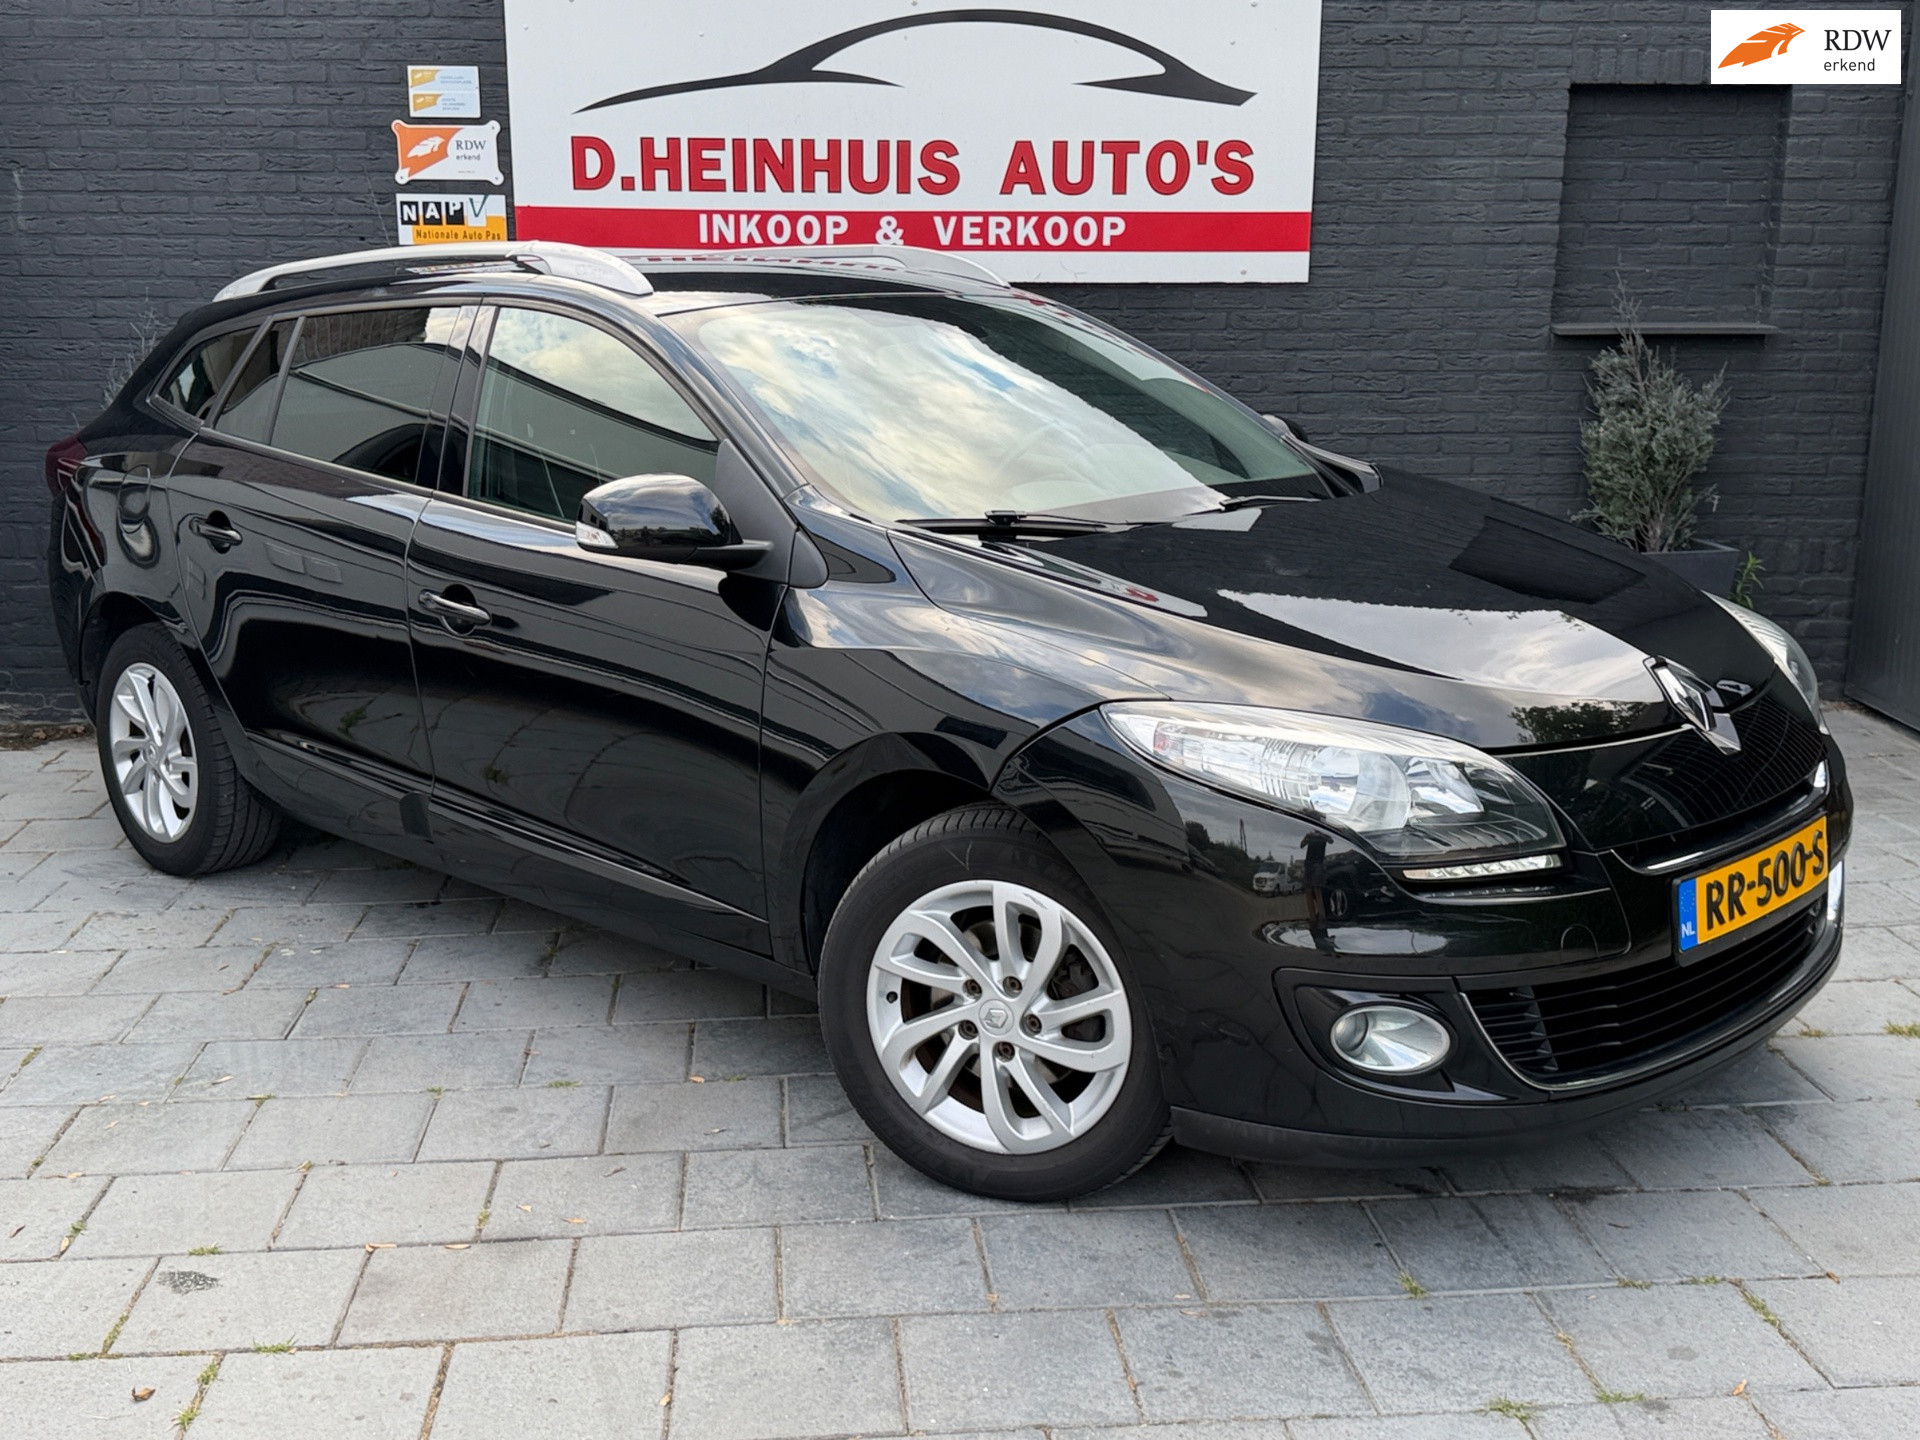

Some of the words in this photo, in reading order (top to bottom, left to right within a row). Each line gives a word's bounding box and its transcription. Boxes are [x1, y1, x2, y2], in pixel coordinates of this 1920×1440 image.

[455, 140, 487, 151] RDW
[571, 136, 960, 195] D.HEINHUIS
[1001, 139, 1254, 196] AUTO'S
[415, 229, 459, 240] Nationale
[462, 230, 483, 241] Auto
[485, 230, 501, 241] Pas
[699, 213, 849, 245] INKOOP
[874, 215, 905, 246] &
[933, 215, 1126, 247] VERKOOP
[1706, 830, 1825, 931] RR-500-S
[1681, 921, 1696, 938] NL
